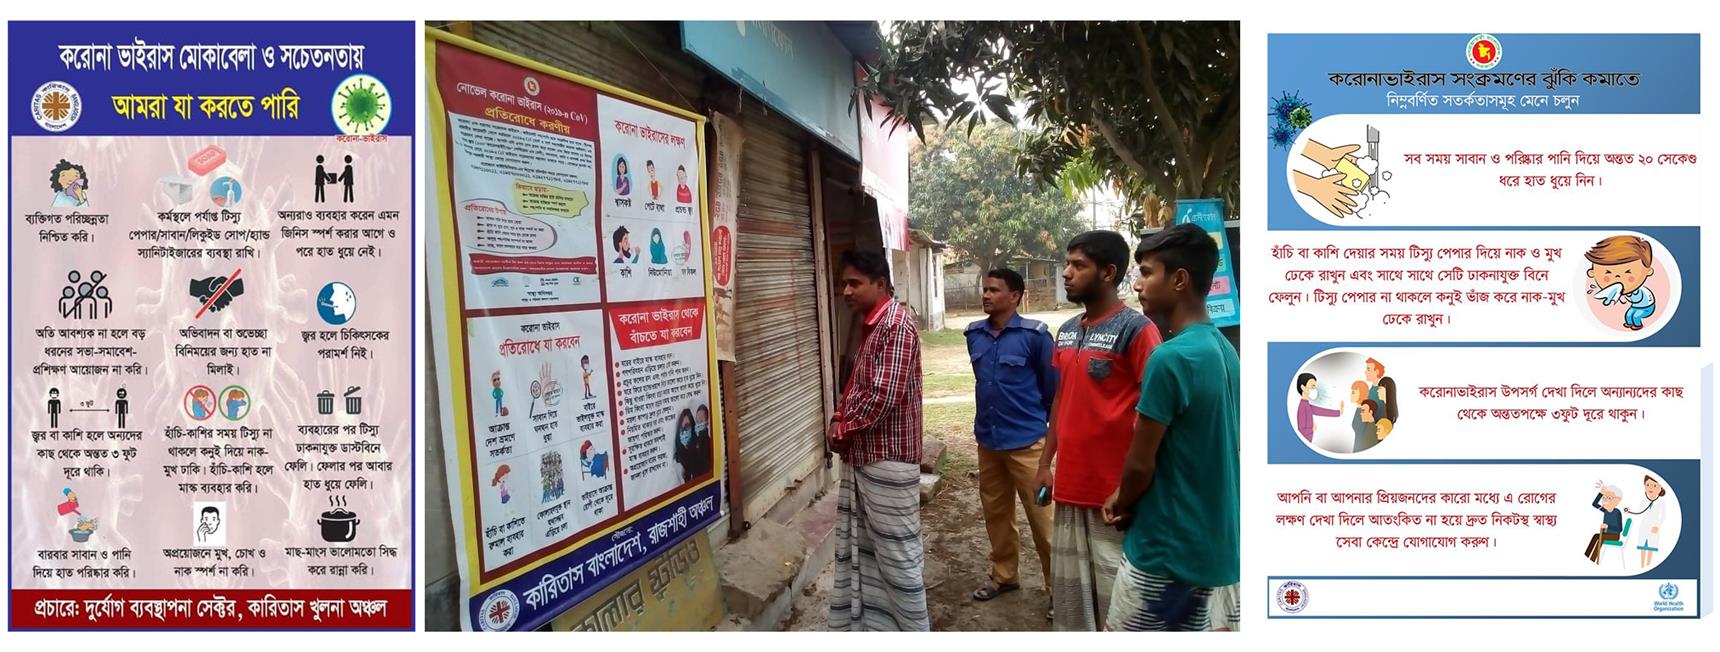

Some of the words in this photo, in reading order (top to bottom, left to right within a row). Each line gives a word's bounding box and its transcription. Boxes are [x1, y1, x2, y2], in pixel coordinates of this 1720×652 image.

[58, 43, 113, 70] করোনা
[117, 37, 175, 70] ভাইরাস
[180, 43, 257, 70] মোকাবেলা
[262, 47, 274, 67] ও
[279, 44, 365, 69] সচেতনতায়
[1328, 70, 1445, 86] করোনাভাইরাস
[1451, 73, 1536, 88] সংক্রমণের
[1542, 69, 1577, 90] ঝুঁকি
[1582, 73, 1639, 85] কমাতে
[113, 95, 166, 117] আমরা
[173, 96, 191, 117] যা
[200, 96, 252, 118] করতে
[261, 88, 298, 117] পারি
[457, 82, 487, 98] নোভেল
[489, 90, 515, 105] করোনা
[517, 96, 542, 111] ভাইরাস
[1387, 92, 1438, 108] নিম্নবর্ণিত
[1443, 92, 1515, 109] সতর্কতাসমূহ
[1521, 96, 1548, 106] মেনে
[1553, 96, 1580, 109] চলুন
[484, 106, 537, 127] প্রতিরোধে
[539, 120, 571, 135] করণীয়
[614, 120, 638, 137] করোনা
[1404, 154, 1421, 164] সব
[1426, 154, 1451, 164] সময়
[1455, 154, 1487, 164] সাবান
[1491, 154, 1500, 164] ও
[1548, 150, 1571, 164] পানি
[1575, 150, 1600, 165] দিয়ে
[1604, 154, 1634, 164] অন্তত
[1639, 155, 1653, 165] ২০
[25, 212, 62, 224] ব্যক্তিগত
[65, 212, 109, 225] পরিচ্ছন্নতা
[157, 209, 191, 223] কর্মস্থলে
[195, 209, 218, 221] পর্যাপ্ত
[221, 209, 241, 224] টিস্যু
[278, 211, 312, 220] অন্যরাও
[316, 211, 347, 221] ব্যবহার
[350, 211, 374, 220] করেন
[378, 211, 399, 220] এমন
[1271, 244, 1294, 259] হাঁচি
[1297, 248, 1309, 258] বা
[1313, 245, 1339, 258] কাশি
[1344, 248, 1376, 259] দেয়ার
[1379, 249, 1405, 258] সময়
[1409, 244, 1433, 262] টিস্যু
[1437, 248, 1472, 259] পেপার
[1476, 245, 1501, 259] দিয়ে
[1505, 248, 1526, 258] নাক
[1531, 249, 1540, 258] ও
[1545, 248, 1562, 262] মুখ
[618, 312, 649, 326] করোনা
[652, 308, 680, 322] ভাইরাস
[681, 307, 699, 319] থেকে
[36, 326, 55, 338] অতি
[58, 329, 95, 338] আবশ্যক
[98, 329, 107, 338] না
[111, 330, 128, 339] হলে
[132, 329, 145, 340] বড়
[179, 326, 220, 338] অভিবাদন
[223, 329, 232, 338] বা
[236, 329, 267, 339] শুভেচ্ছা
[301, 331, 316, 343] জ্বর
[319, 331, 337, 341] হলে
[340, 328, 389, 340] চিকিৎসকের
[520, 323, 540, 333] করোনা
[629, 329, 658, 346] বাঁচতে
[660, 329, 669, 340] যা
[499, 338, 541, 358] প্রতিরোধে
[543, 339, 553, 352] যা
[555, 335, 580, 349] করবেন
[1419, 384, 1497, 398] করোনাভাইরাস
[1501, 384, 1538, 397] উপসর্গ
[1542, 387, 1567, 398] দেখা
[1571, 384, 1597, 398] দিলে
[1601, 387, 1657, 398] অন্যান্যদের
[1661, 387, 1683, 398] কাছ
[1458, 409, 1487, 420] থেকে
[1491, 409, 1547, 420] অন্ততপক্ষে
[1552, 407, 1579, 423] ৩ফুট
[1583, 409, 1604, 422] দূরে
[32, 431, 46, 443] জ্বর
[50, 431, 59, 440] বা
[62, 428, 83, 440] কাশি
[86, 431, 104, 441] হলে
[107, 431, 142, 440] অন্যদের
[298, 426, 339, 435] ব্যবহারের
[343, 425, 356, 434] পর
[359, 422, 379, 436] টিস্যু
[1277, 489, 1312, 503] আপনি
[1316, 493, 1327, 503] বা
[1331, 493, 1373, 503] আপনার
[1376, 489, 1437, 504] প্রিয়জনদের
[1440, 493, 1470, 503] কারো
[1474, 493, 1500, 504] মধ্যে
[1504, 493, 1512, 503] এ
[1518, 493, 1556, 504] রোগের
[330, 547, 376, 557] ভালোমতো
[379, 545, 397, 557] সিদ্ধ
[523, 562, 585, 611] কারিতাস
[586, 532, 648, 577] বাংলাদেশ,
[647, 506, 688, 545] রাজশাহী
[688, 495, 714, 520] অঞ্চল
[35, 599, 79, 617] প্রচারে:
[84, 594, 125, 621] দুর্যোগ
[129, 599, 192, 621] ব্যবস্থাপনা
[197, 595, 242, 621] সেক্টর,
[247, 594, 305, 617] কারিতাস
[310, 598, 345, 622] খুলনা
[349, 600, 388, 616] অঞ্চল
